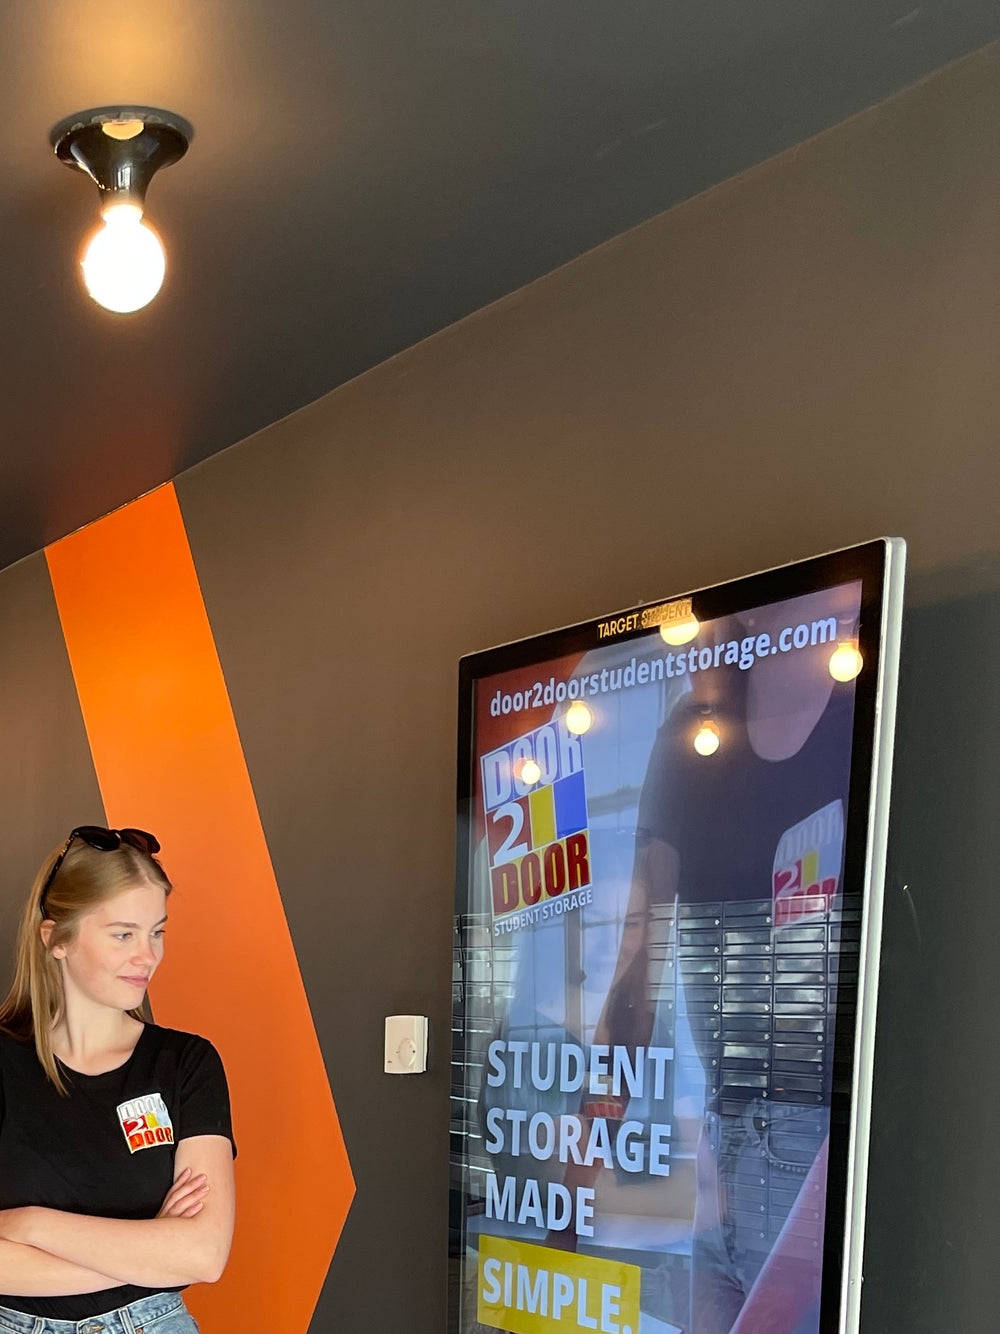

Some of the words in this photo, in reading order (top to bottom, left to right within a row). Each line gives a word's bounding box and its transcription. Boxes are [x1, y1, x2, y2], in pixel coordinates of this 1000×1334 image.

[598, 613, 640, 639] TARGET
[489, 616, 838, 717] door2doorstudentstorage.com
[492, 802, 529, 866] 2
[491, 833, 591, 916] DOOR
[494, 908, 541, 937] STUDENT
[542, 889, 593, 920] STORAGE
[486, 1039, 675, 1101] STUDENT
[128, 1127, 173, 1151] DOOR
[485, 1107, 672, 1177] STORAGE
[485, 1173, 596, 1238] MADE
